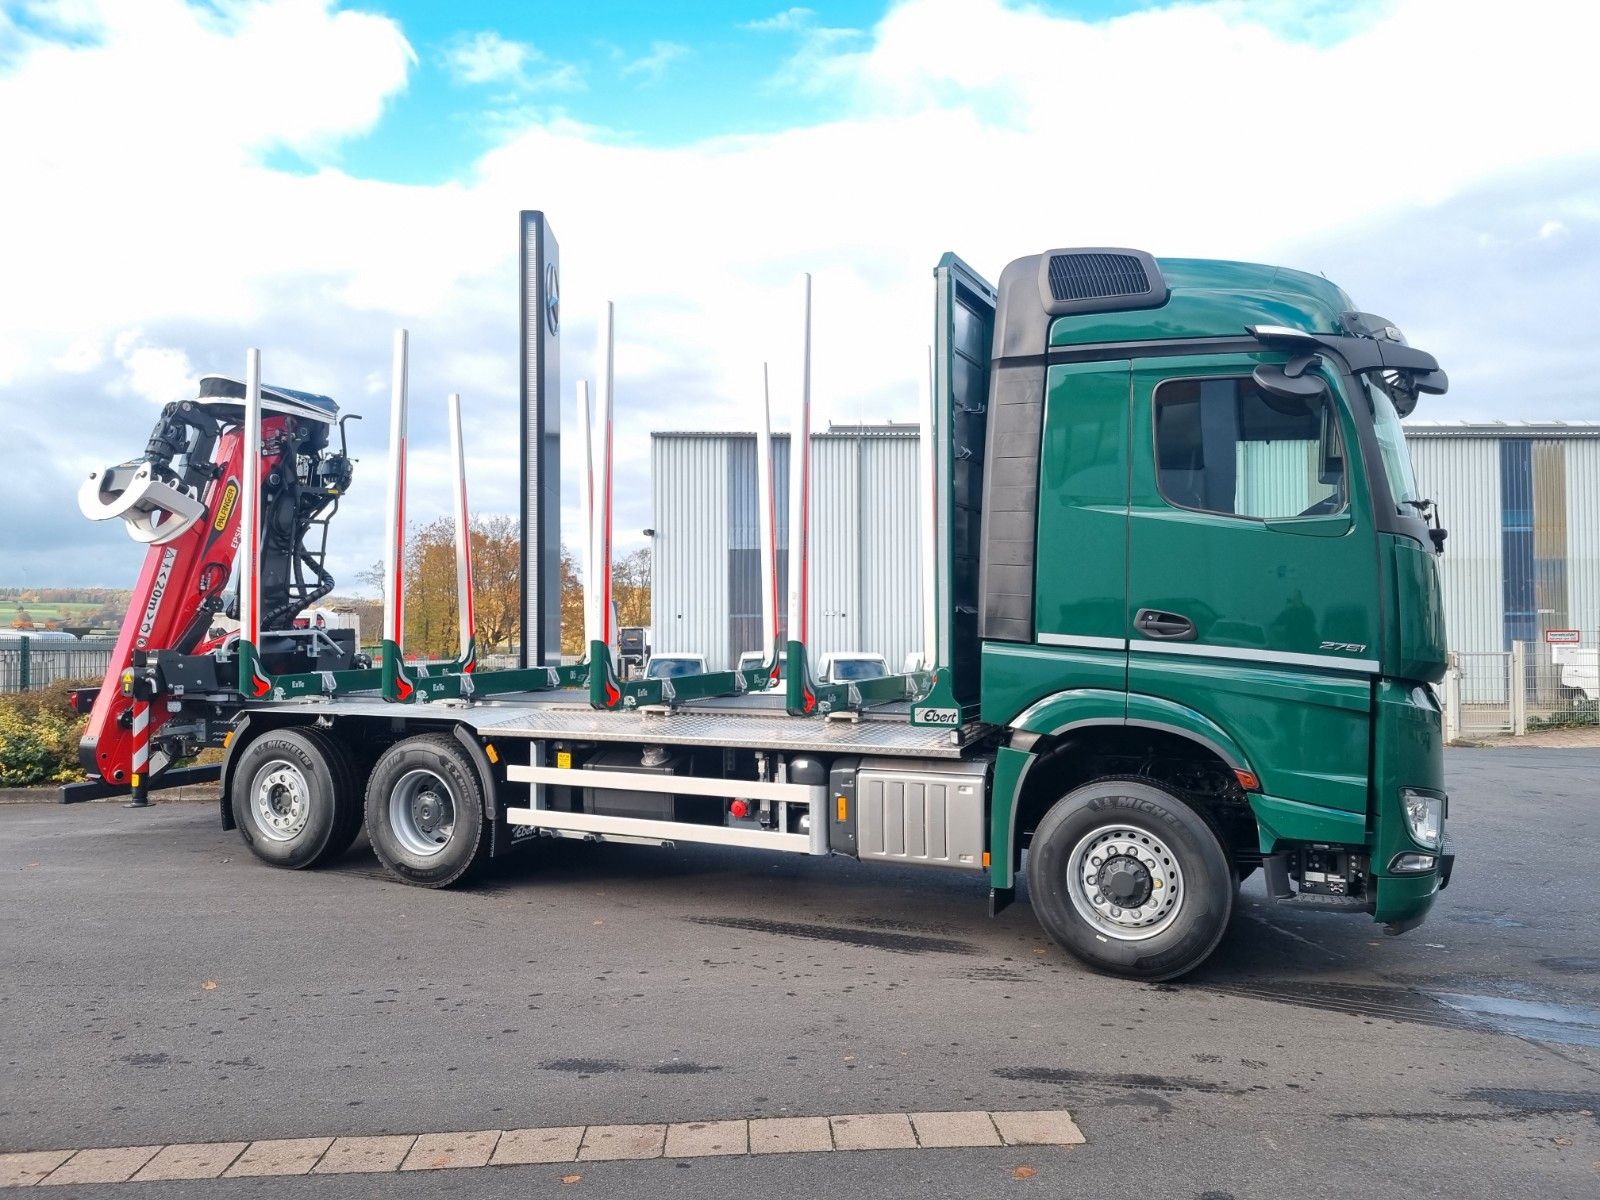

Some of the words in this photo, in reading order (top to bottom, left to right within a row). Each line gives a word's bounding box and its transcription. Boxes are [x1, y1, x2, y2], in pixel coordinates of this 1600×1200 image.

[216, 487, 235, 530] PALFINGER
[231, 523, 242, 549] EPSIL
[1319, 641, 1367, 653] 2751
[924, 709, 957, 723] Ebert
[267, 740, 312, 767] MICHELIN
[1118, 796, 1187, 834] MICHE
